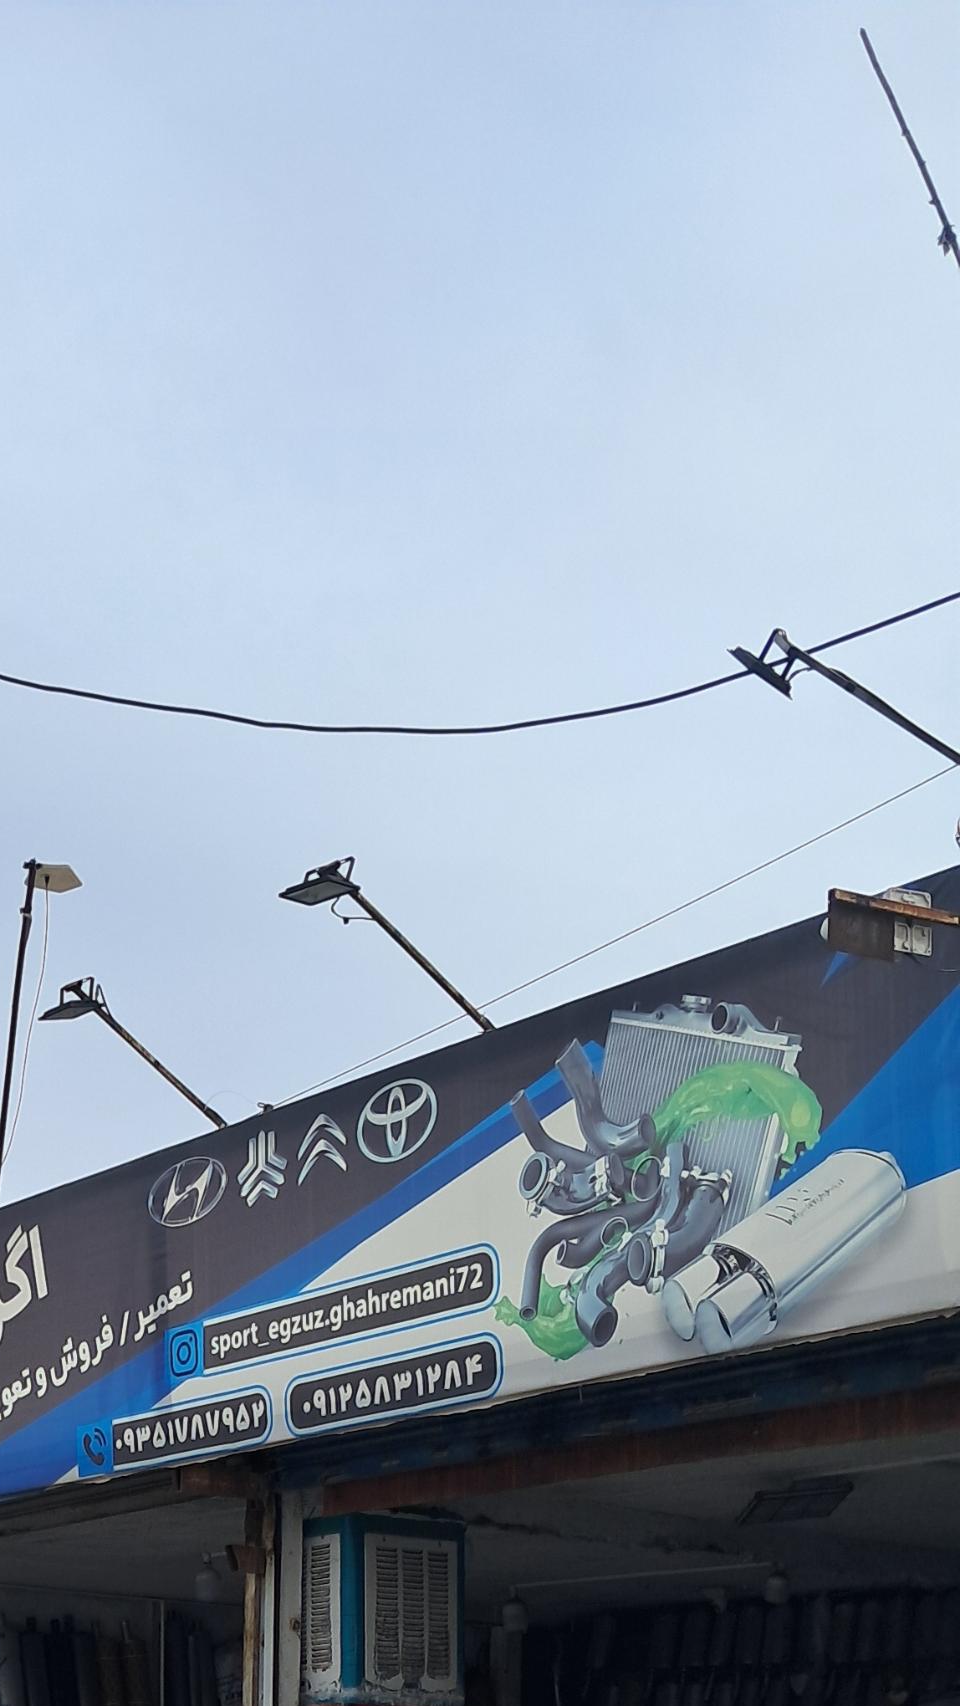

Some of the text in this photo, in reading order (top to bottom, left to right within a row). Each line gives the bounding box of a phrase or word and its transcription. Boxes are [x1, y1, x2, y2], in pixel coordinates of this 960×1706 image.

[133, 1270, 193, 1342] تعمیر
[210, 1262, 483, 1358] sport_egzuz.ghahremani72
[35, 1366, 47, 1398] و
[50, 1314, 114, 1388] فروش
[302, 1353, 483, 1417] ۰۹۱۲۵۸۳۱۲۸۴
[115, 1399, 265, 1453] ۰۹۳۵۱۷۸۷۹۵۲
